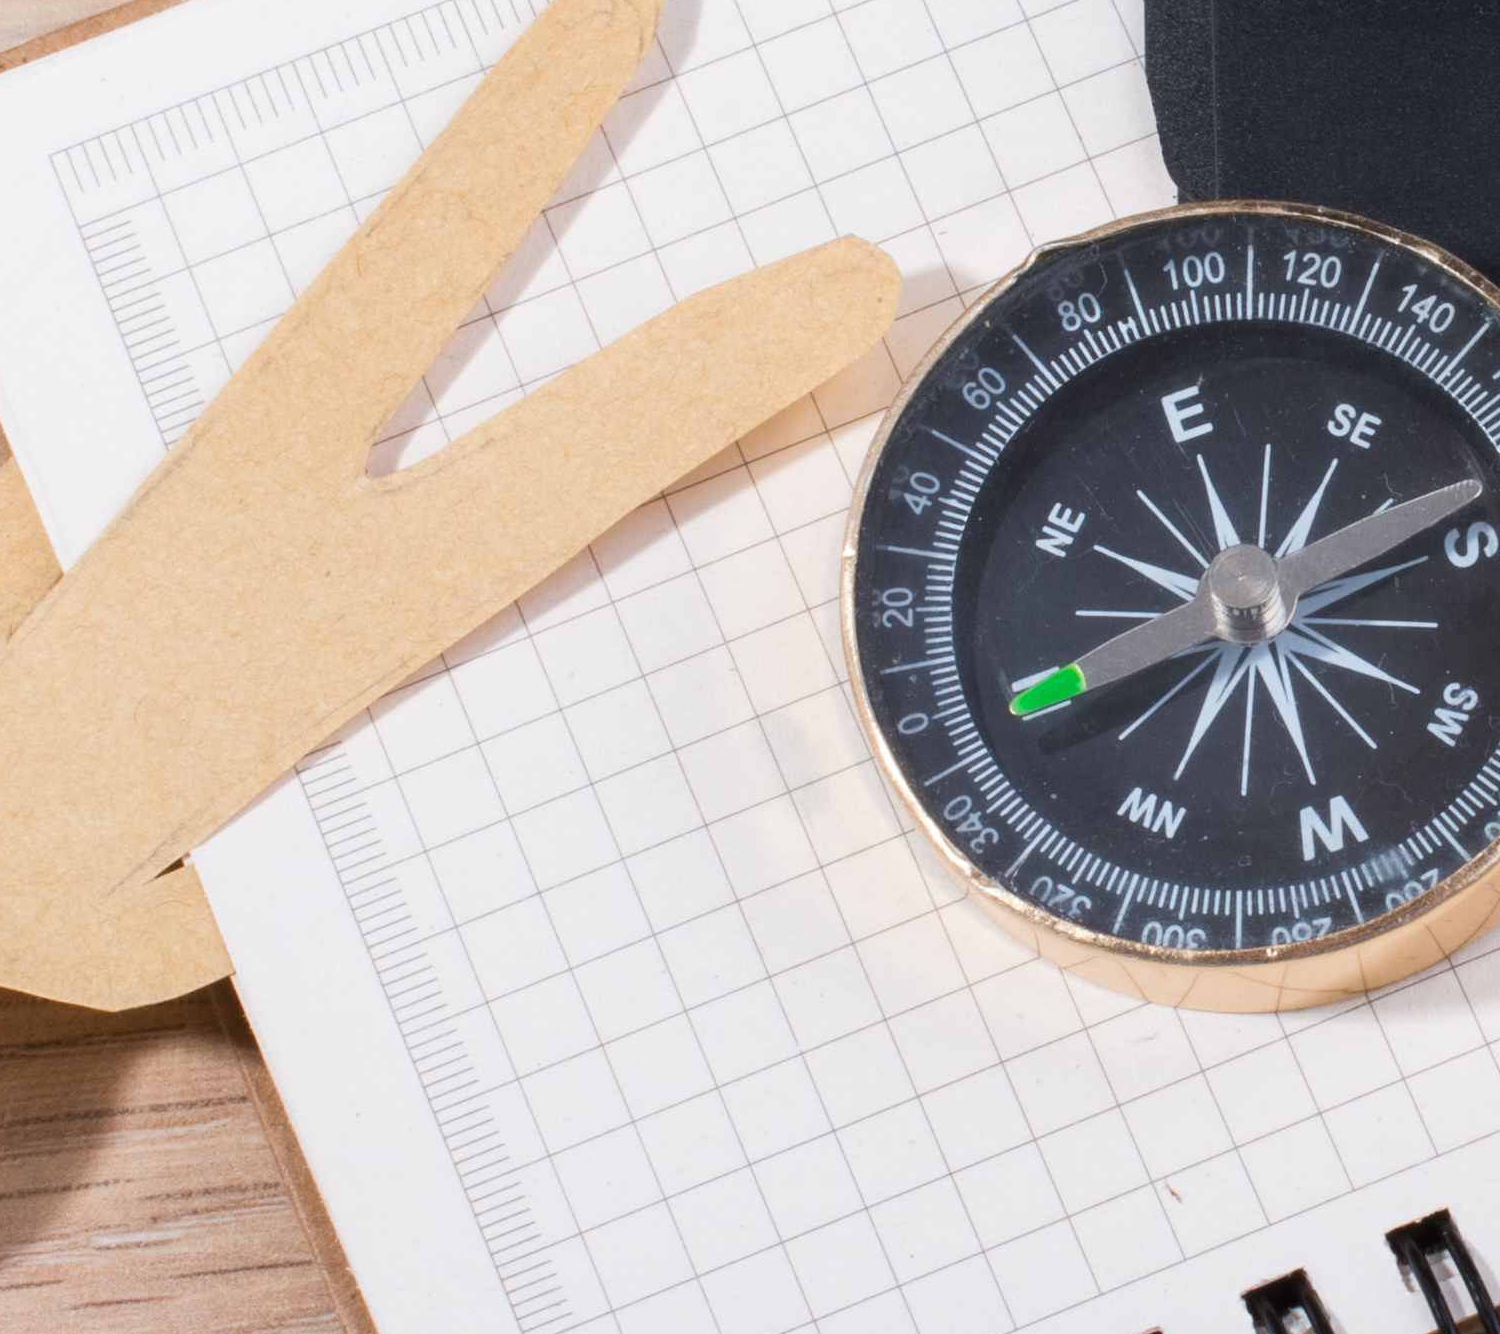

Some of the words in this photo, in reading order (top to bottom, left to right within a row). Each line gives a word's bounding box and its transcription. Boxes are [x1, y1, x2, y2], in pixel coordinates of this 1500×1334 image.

[1162, 249, 1226, 291] 100
[1282, 249, 1344, 287] 120
[1057, 291, 1101, 332] 80
[1396, 281, 1455, 333] 140
[961, 366, 1007, 410] 60
[1160, 384, 1215, 445] E
[1326, 401, 1383, 450] SE
[901, 470, 941, 516] 40
[1034, 501, 1086, 557] NE
[1443, 519, 1500, 568] S
[881, 586, 914, 629] 20
[897, 712, 930, 736] 0
[1425, 681, 1479, 748] SW
[942, 794, 998, 855] 340
[1116, 786, 1187, 839] NW
[1300, 794, 1370, 862] W
[1030, 875, 1092, 917] 320
[1139, 920, 1207, 951] 300
